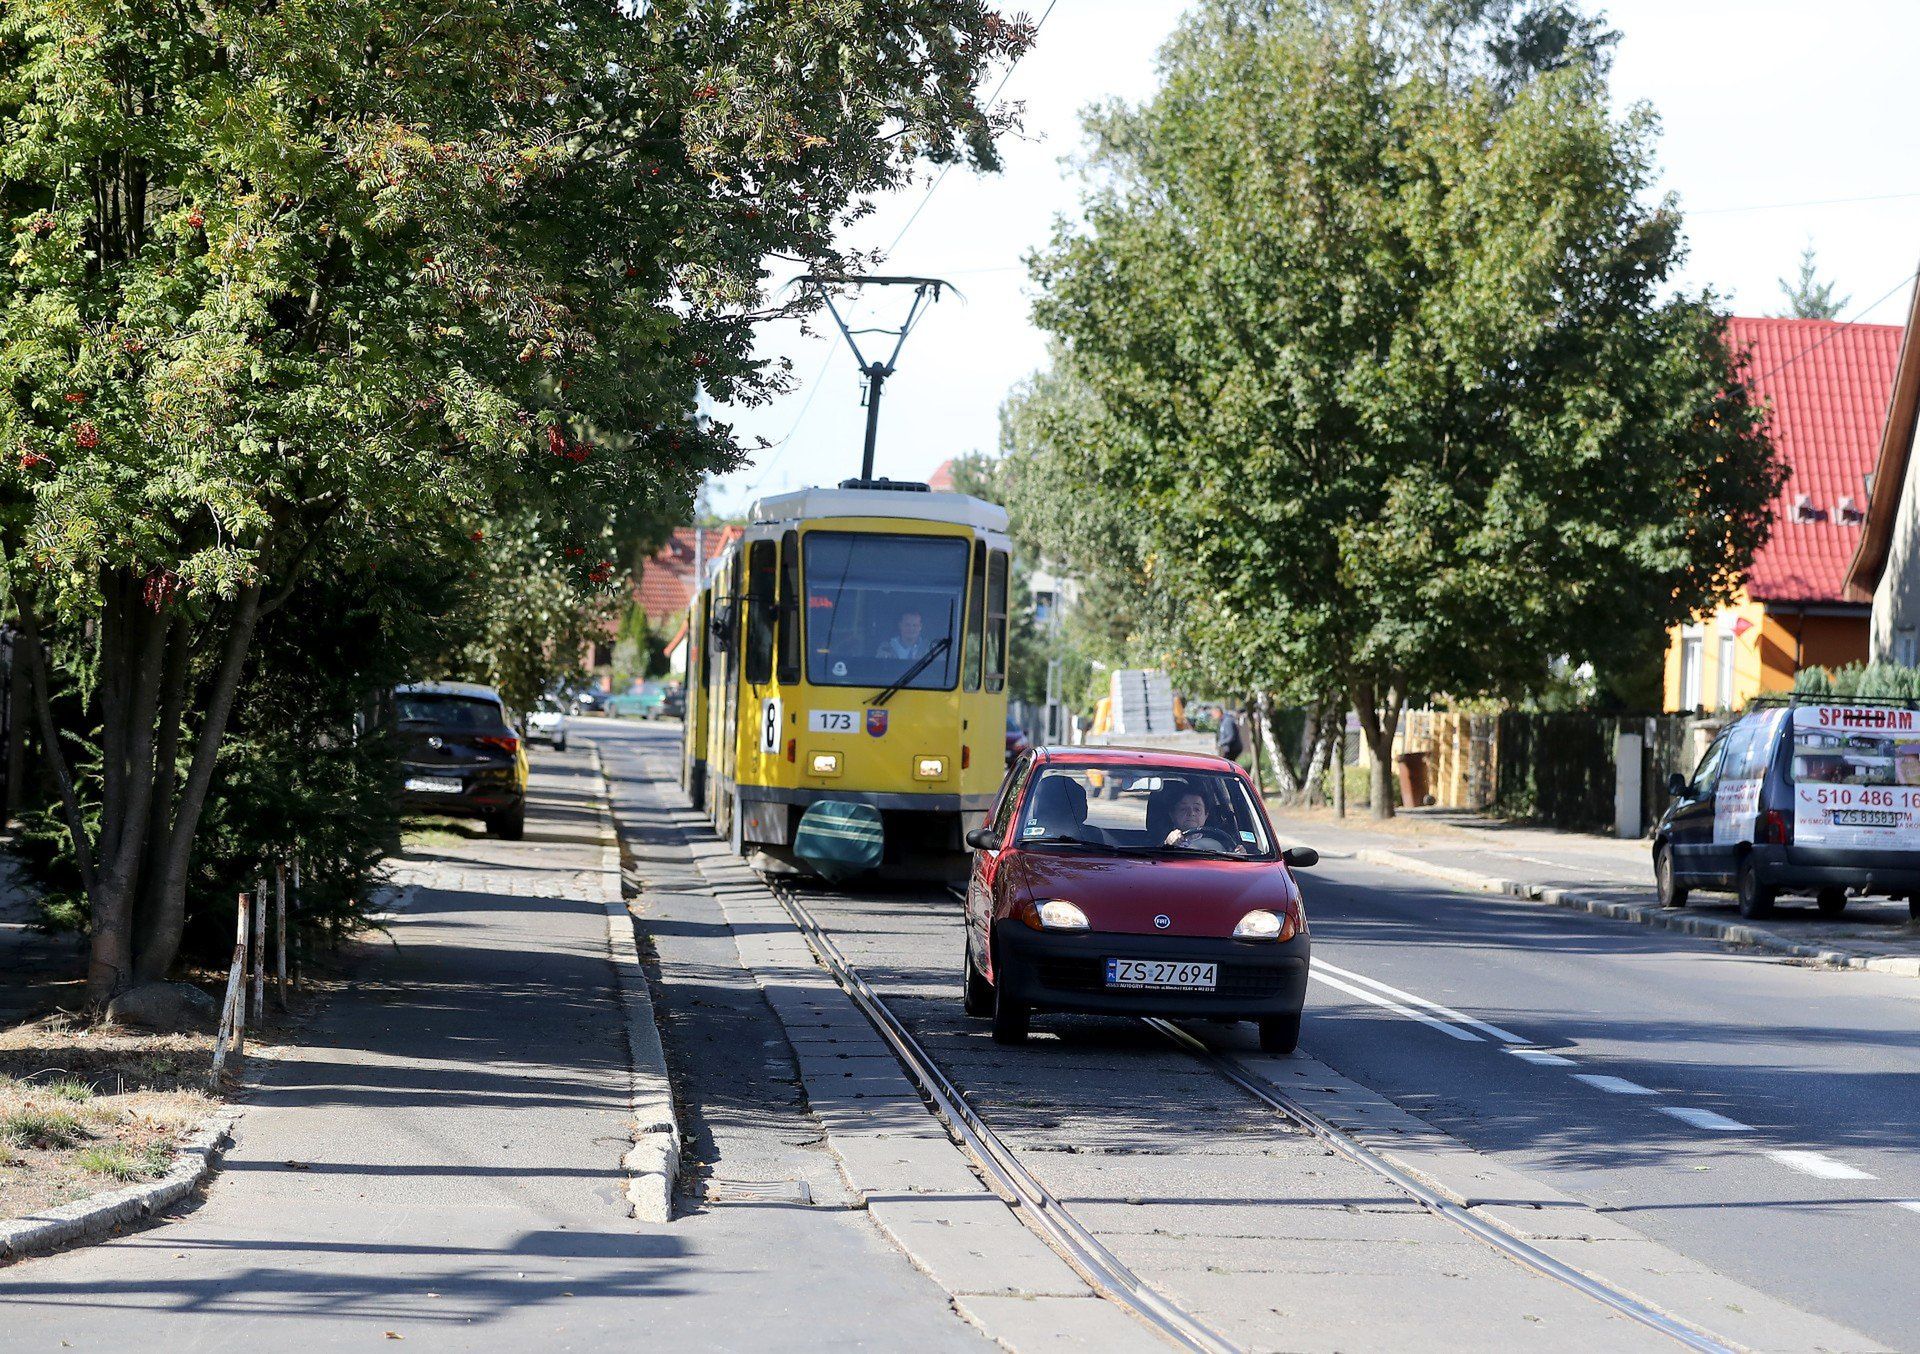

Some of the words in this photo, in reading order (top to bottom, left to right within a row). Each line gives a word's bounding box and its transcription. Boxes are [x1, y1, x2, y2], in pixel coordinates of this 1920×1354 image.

[767, 703, 775, 747] 8
[820, 714, 851, 729] 173
[1817, 788, 1852, 805] 510
[1859, 790, 1894, 807] 486
[1119, 962, 1148, 981] ZS
[1153, 963, 1215, 984] 27694
